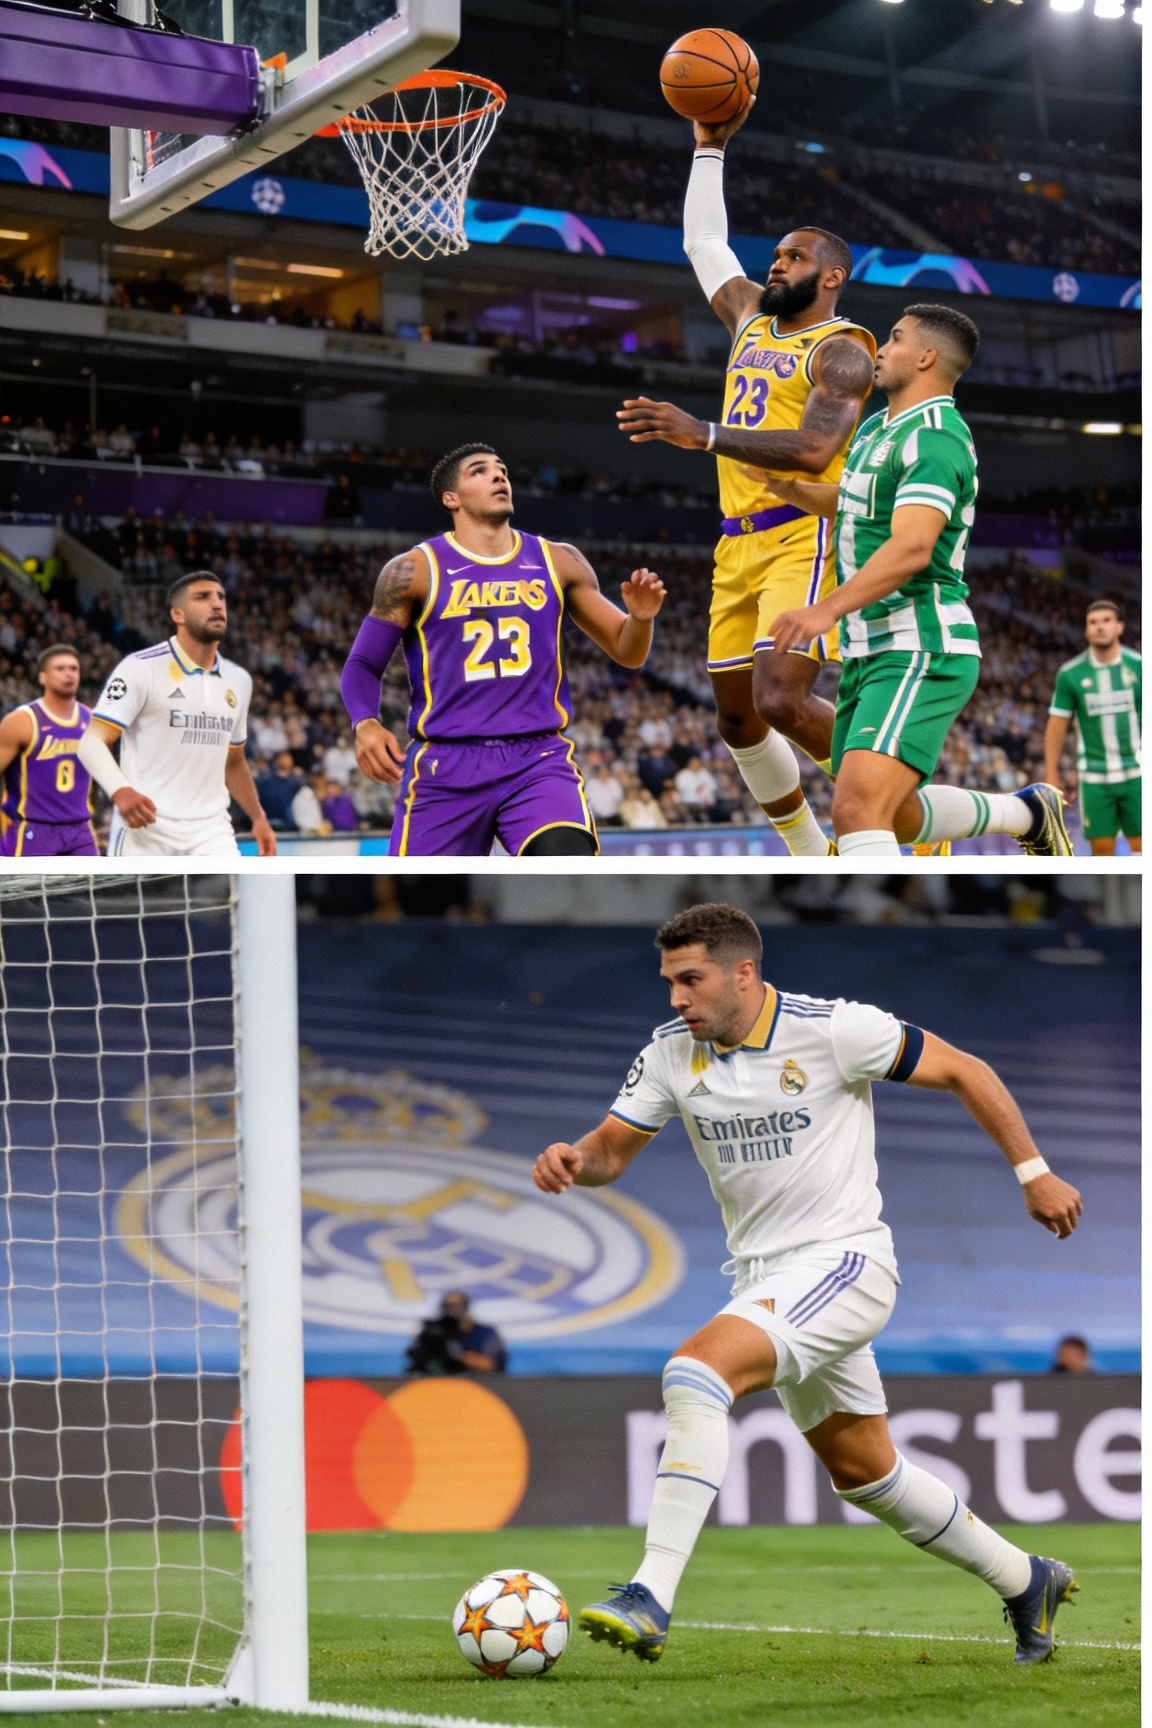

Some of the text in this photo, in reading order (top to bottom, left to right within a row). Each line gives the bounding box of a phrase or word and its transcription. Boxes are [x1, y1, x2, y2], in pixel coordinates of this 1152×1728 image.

[727, 374, 769, 428] 23
[440, 579, 547, 619] LAKERS
[462, 616, 532, 682] 23
[693, 1107, 811, 1141] Emirates
